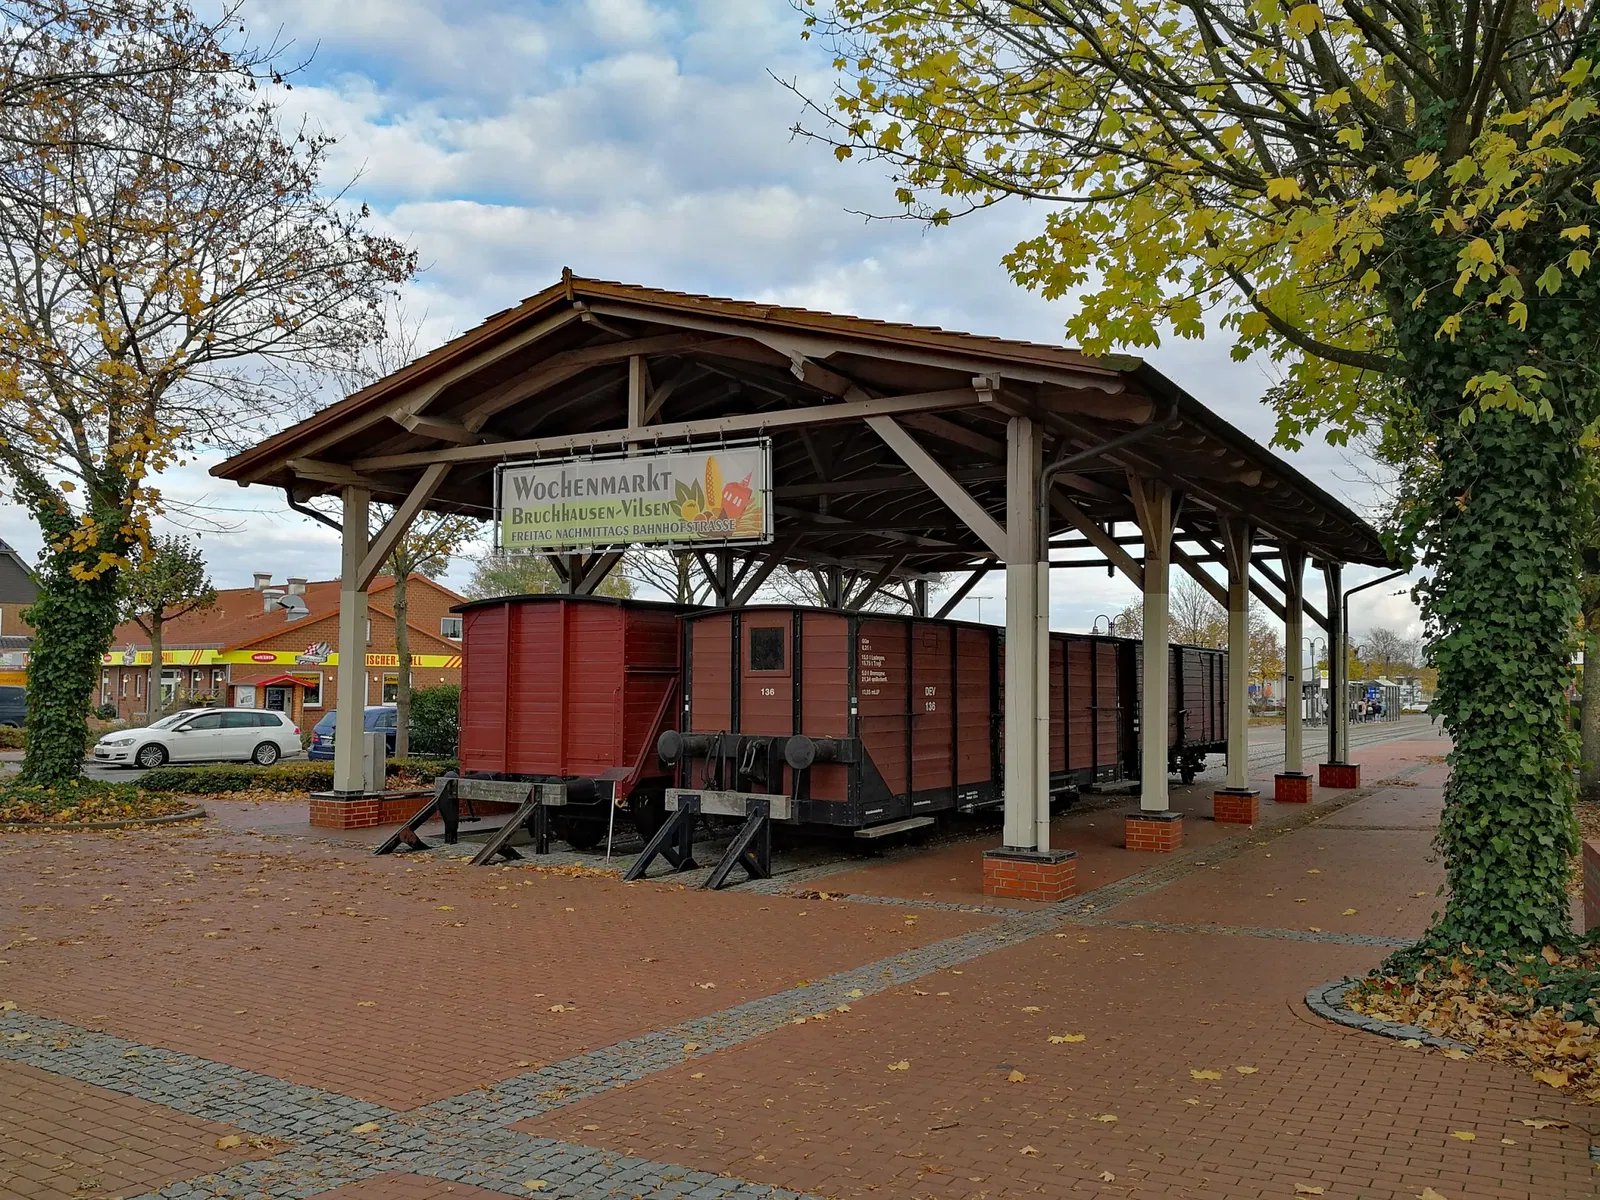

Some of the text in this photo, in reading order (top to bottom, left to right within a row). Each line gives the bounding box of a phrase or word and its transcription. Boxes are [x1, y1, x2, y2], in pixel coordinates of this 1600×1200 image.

[511, 519, 736, 542] FREITAG NACHMITTAGS BAHNHOFSTRASSE
[760, 688, 775, 696] 136
[924, 686, 937, 697] DEV
[925, 701, 936, 712] 136
